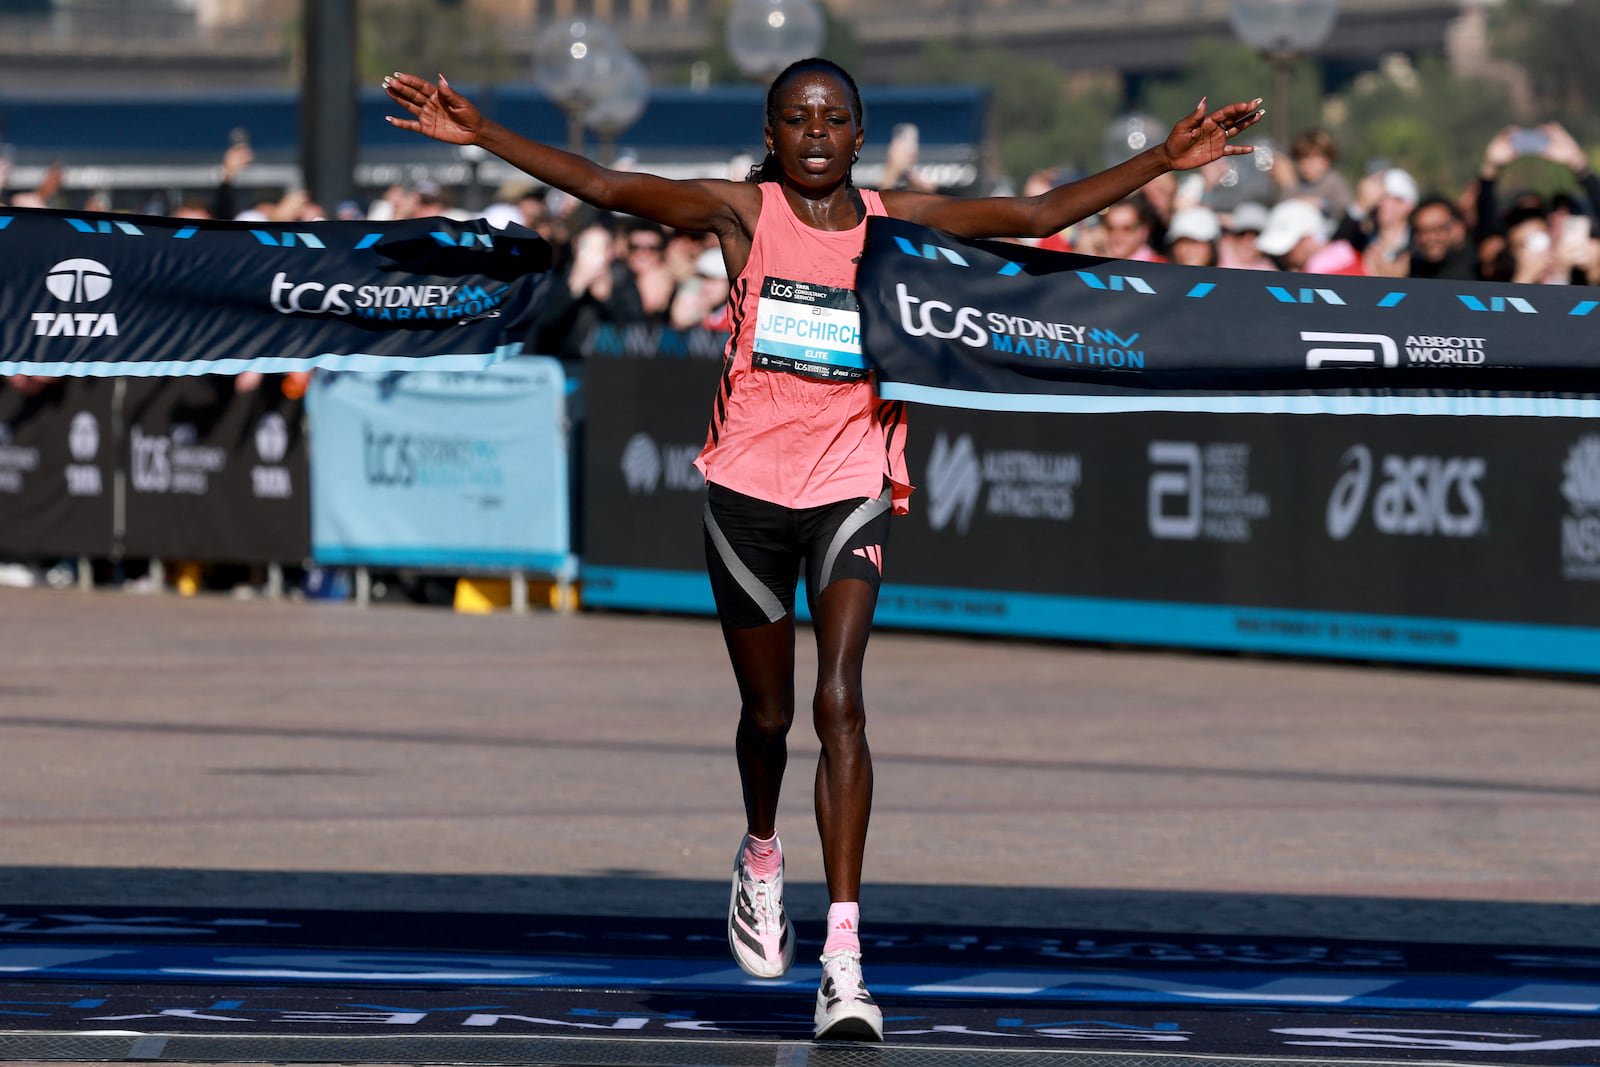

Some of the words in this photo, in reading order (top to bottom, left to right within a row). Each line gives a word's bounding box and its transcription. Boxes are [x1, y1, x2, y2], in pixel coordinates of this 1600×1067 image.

[271, 271, 355, 316] tcs
[355, 285, 458, 308] SYDNEY
[770, 280, 793, 298] tcs
[31, 312, 119, 337] TATA
[896, 282, 988, 347] tcs
[986, 311, 1086, 344] SYDNEY
[761, 314, 862, 346] JEPCHIRCH
[1404, 335, 1487, 349] ABBOTT
[804, 349, 830, 360] ELITE
[991, 333, 1145, 370] MARATHON
[1405, 347, 1486, 365] WORLD
